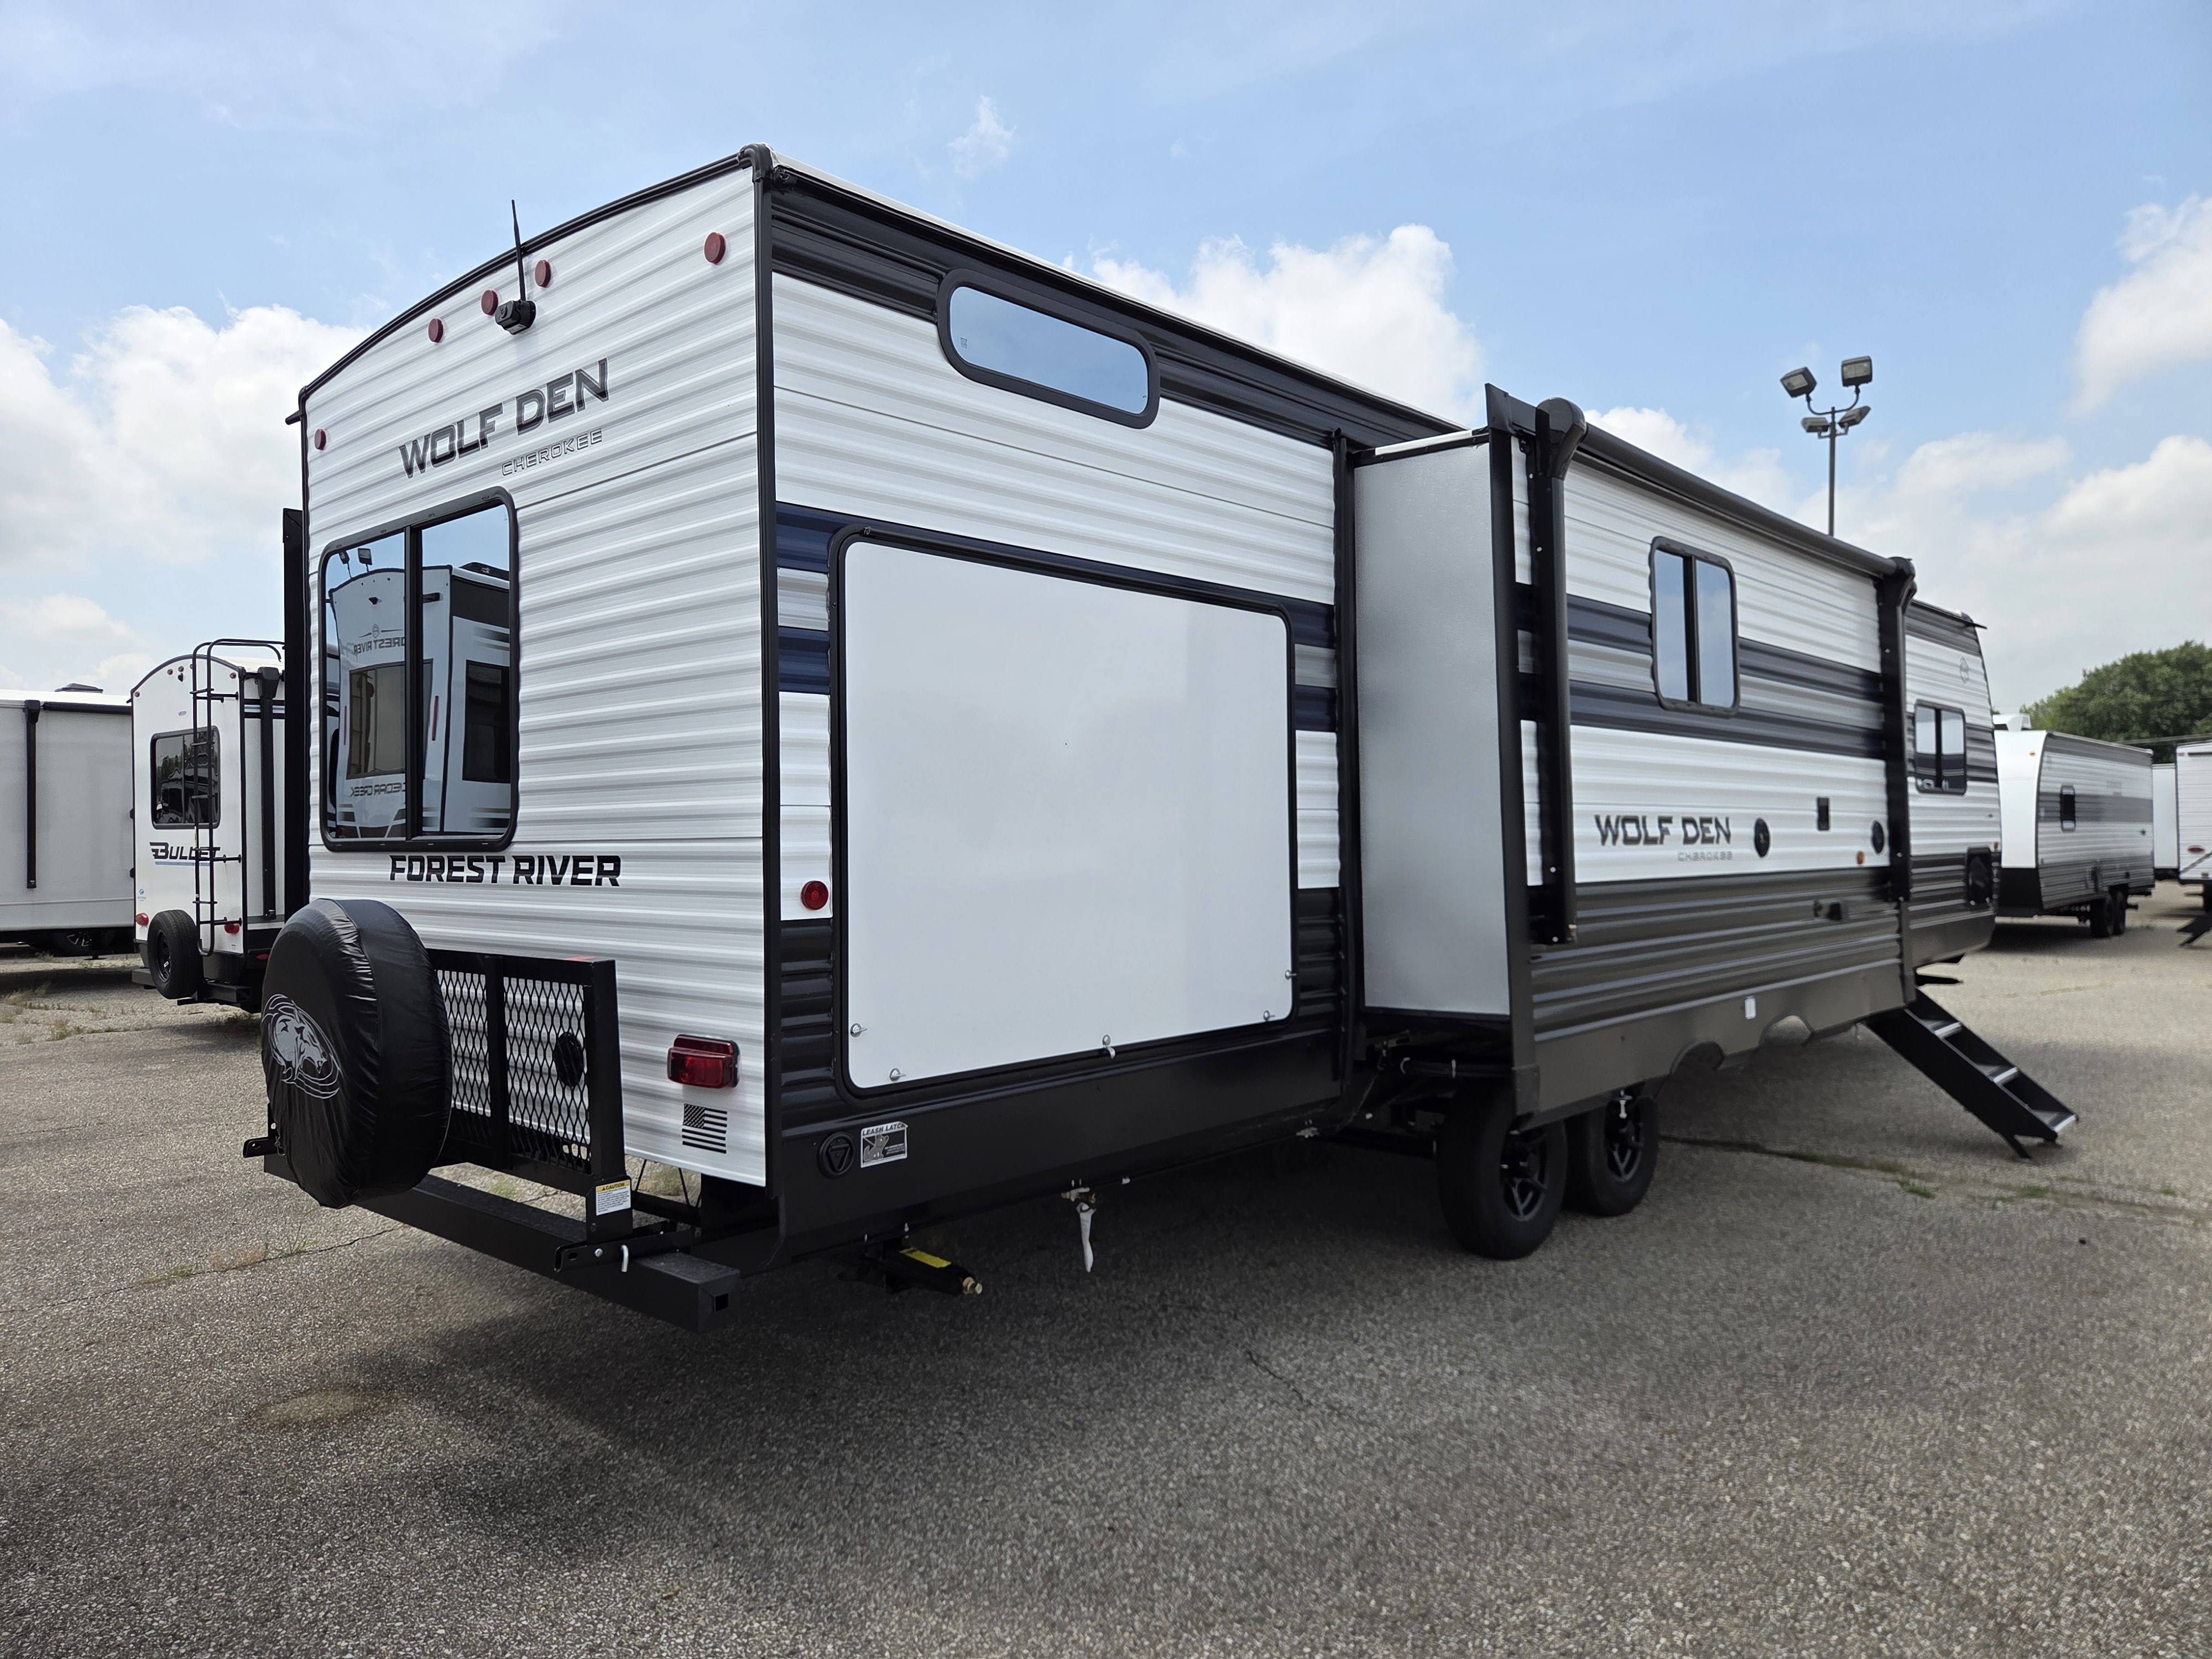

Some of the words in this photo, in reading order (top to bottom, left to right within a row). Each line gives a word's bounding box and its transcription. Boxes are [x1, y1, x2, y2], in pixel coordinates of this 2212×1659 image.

[398, 403, 503, 479] WOLF
[515, 357, 609, 436] DEN
[502, 427, 603, 476] CHEROKEE
[1594, 814, 1673, 846] WOLF
[1681, 816, 1731, 845] DEN
[389, 855, 506, 884] FOREST
[512, 855, 621, 886] RIVER
[863, 1126, 884, 1136] LEASH
[606, 1182, 625, 1190] CAUTION
